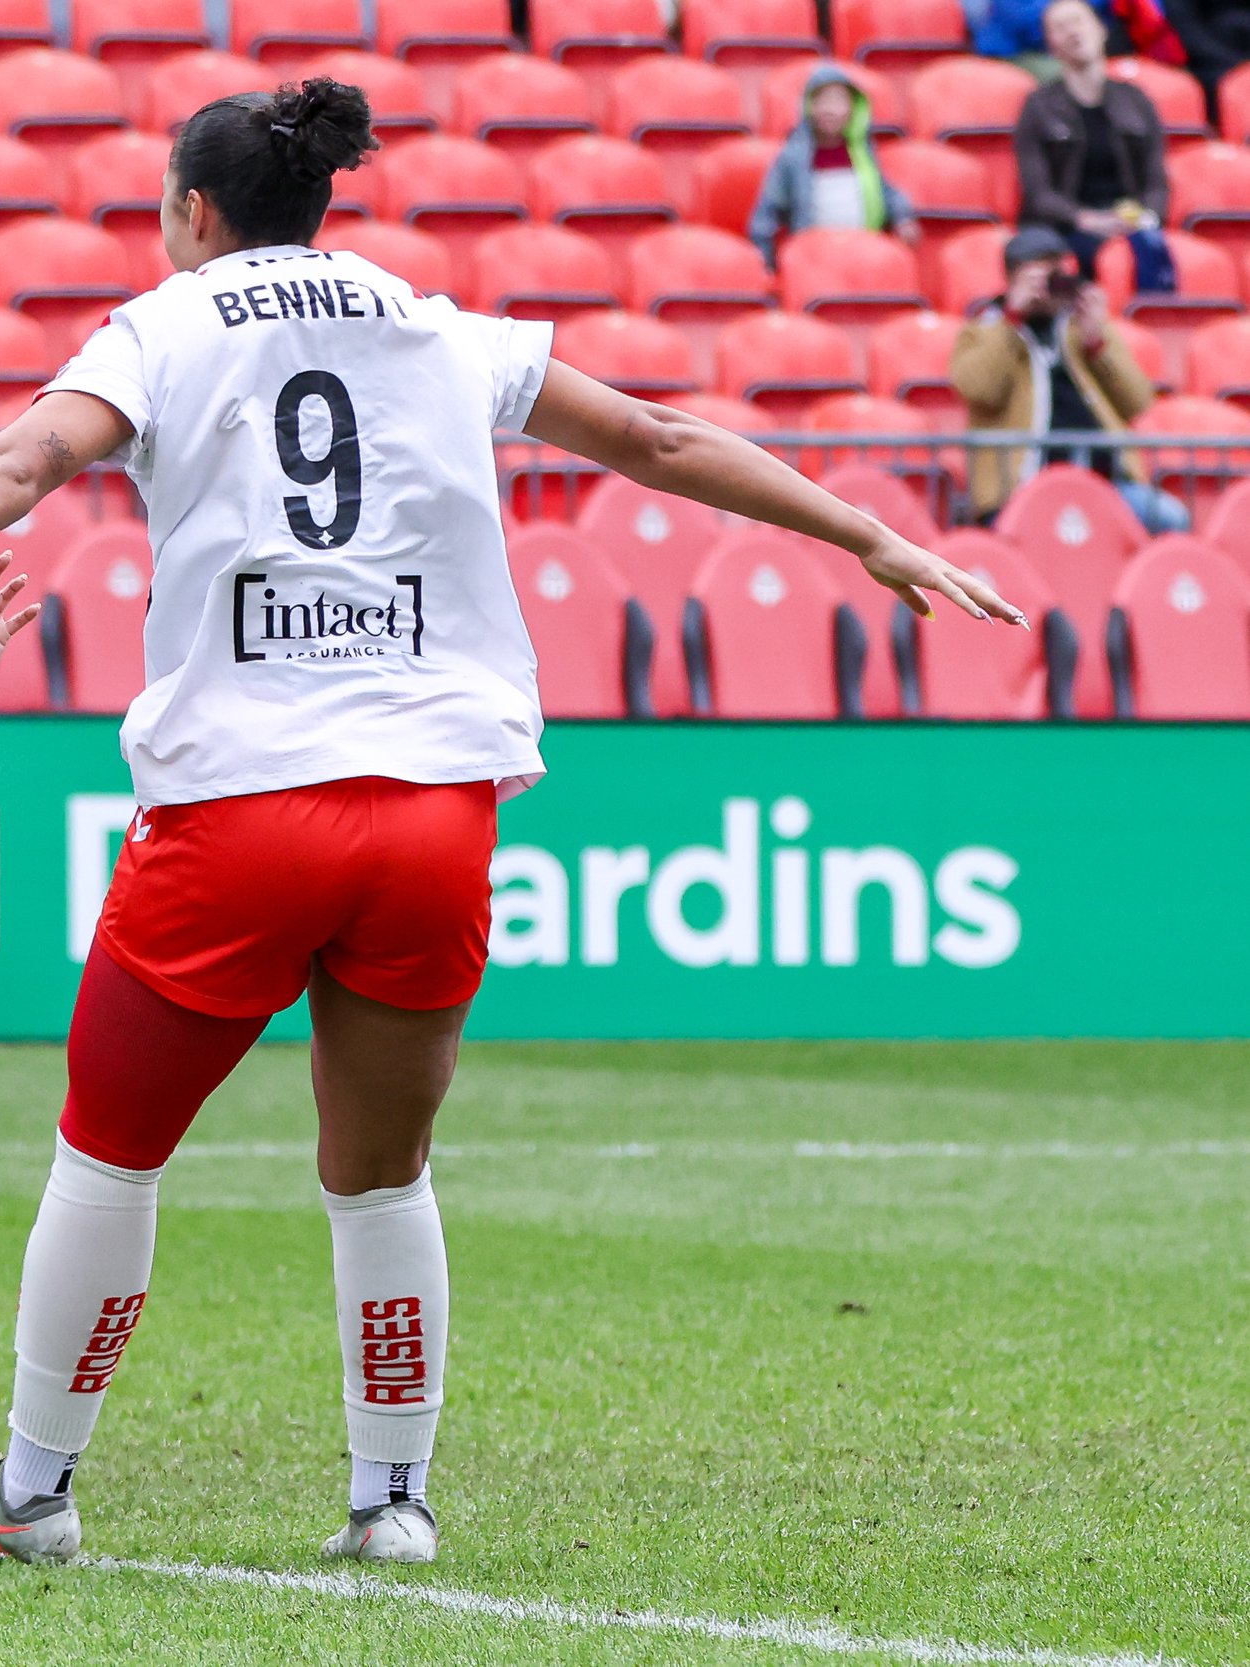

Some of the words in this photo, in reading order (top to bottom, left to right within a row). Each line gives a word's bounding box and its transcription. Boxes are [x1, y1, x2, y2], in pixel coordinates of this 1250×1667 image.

[212, 279, 408, 328] BENNET
[274, 369, 362, 550] 9
[68, 1291, 147, 1393] ROSES
[361, 1296, 426, 1404] ROSES
